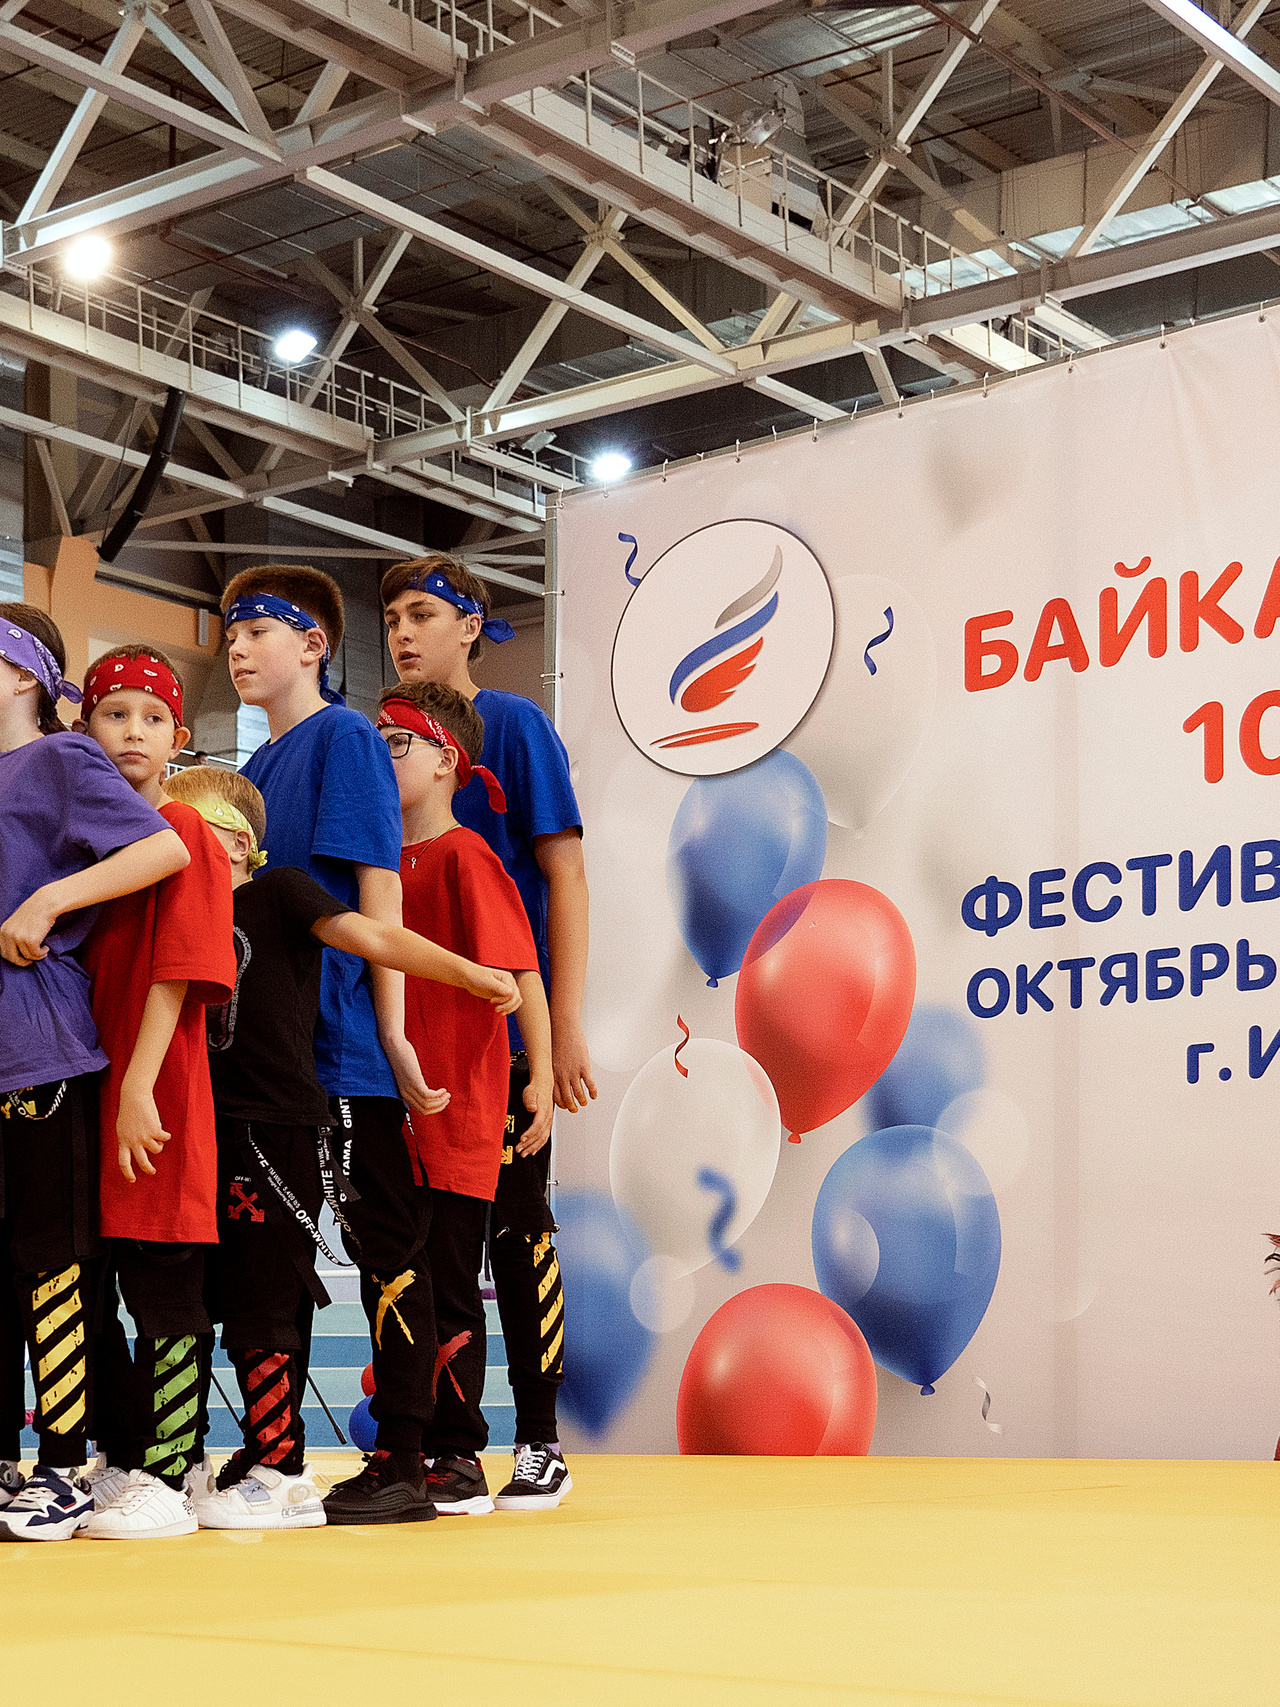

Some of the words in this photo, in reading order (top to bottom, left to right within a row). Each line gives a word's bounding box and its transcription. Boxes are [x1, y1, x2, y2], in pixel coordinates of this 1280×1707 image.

[960, 838, 1280, 937] ФЕСТИВ
[966, 938, 1278, 1018] ОКТЯБРЬ
[295, 1209, 341, 1265] OFF-WHITE
